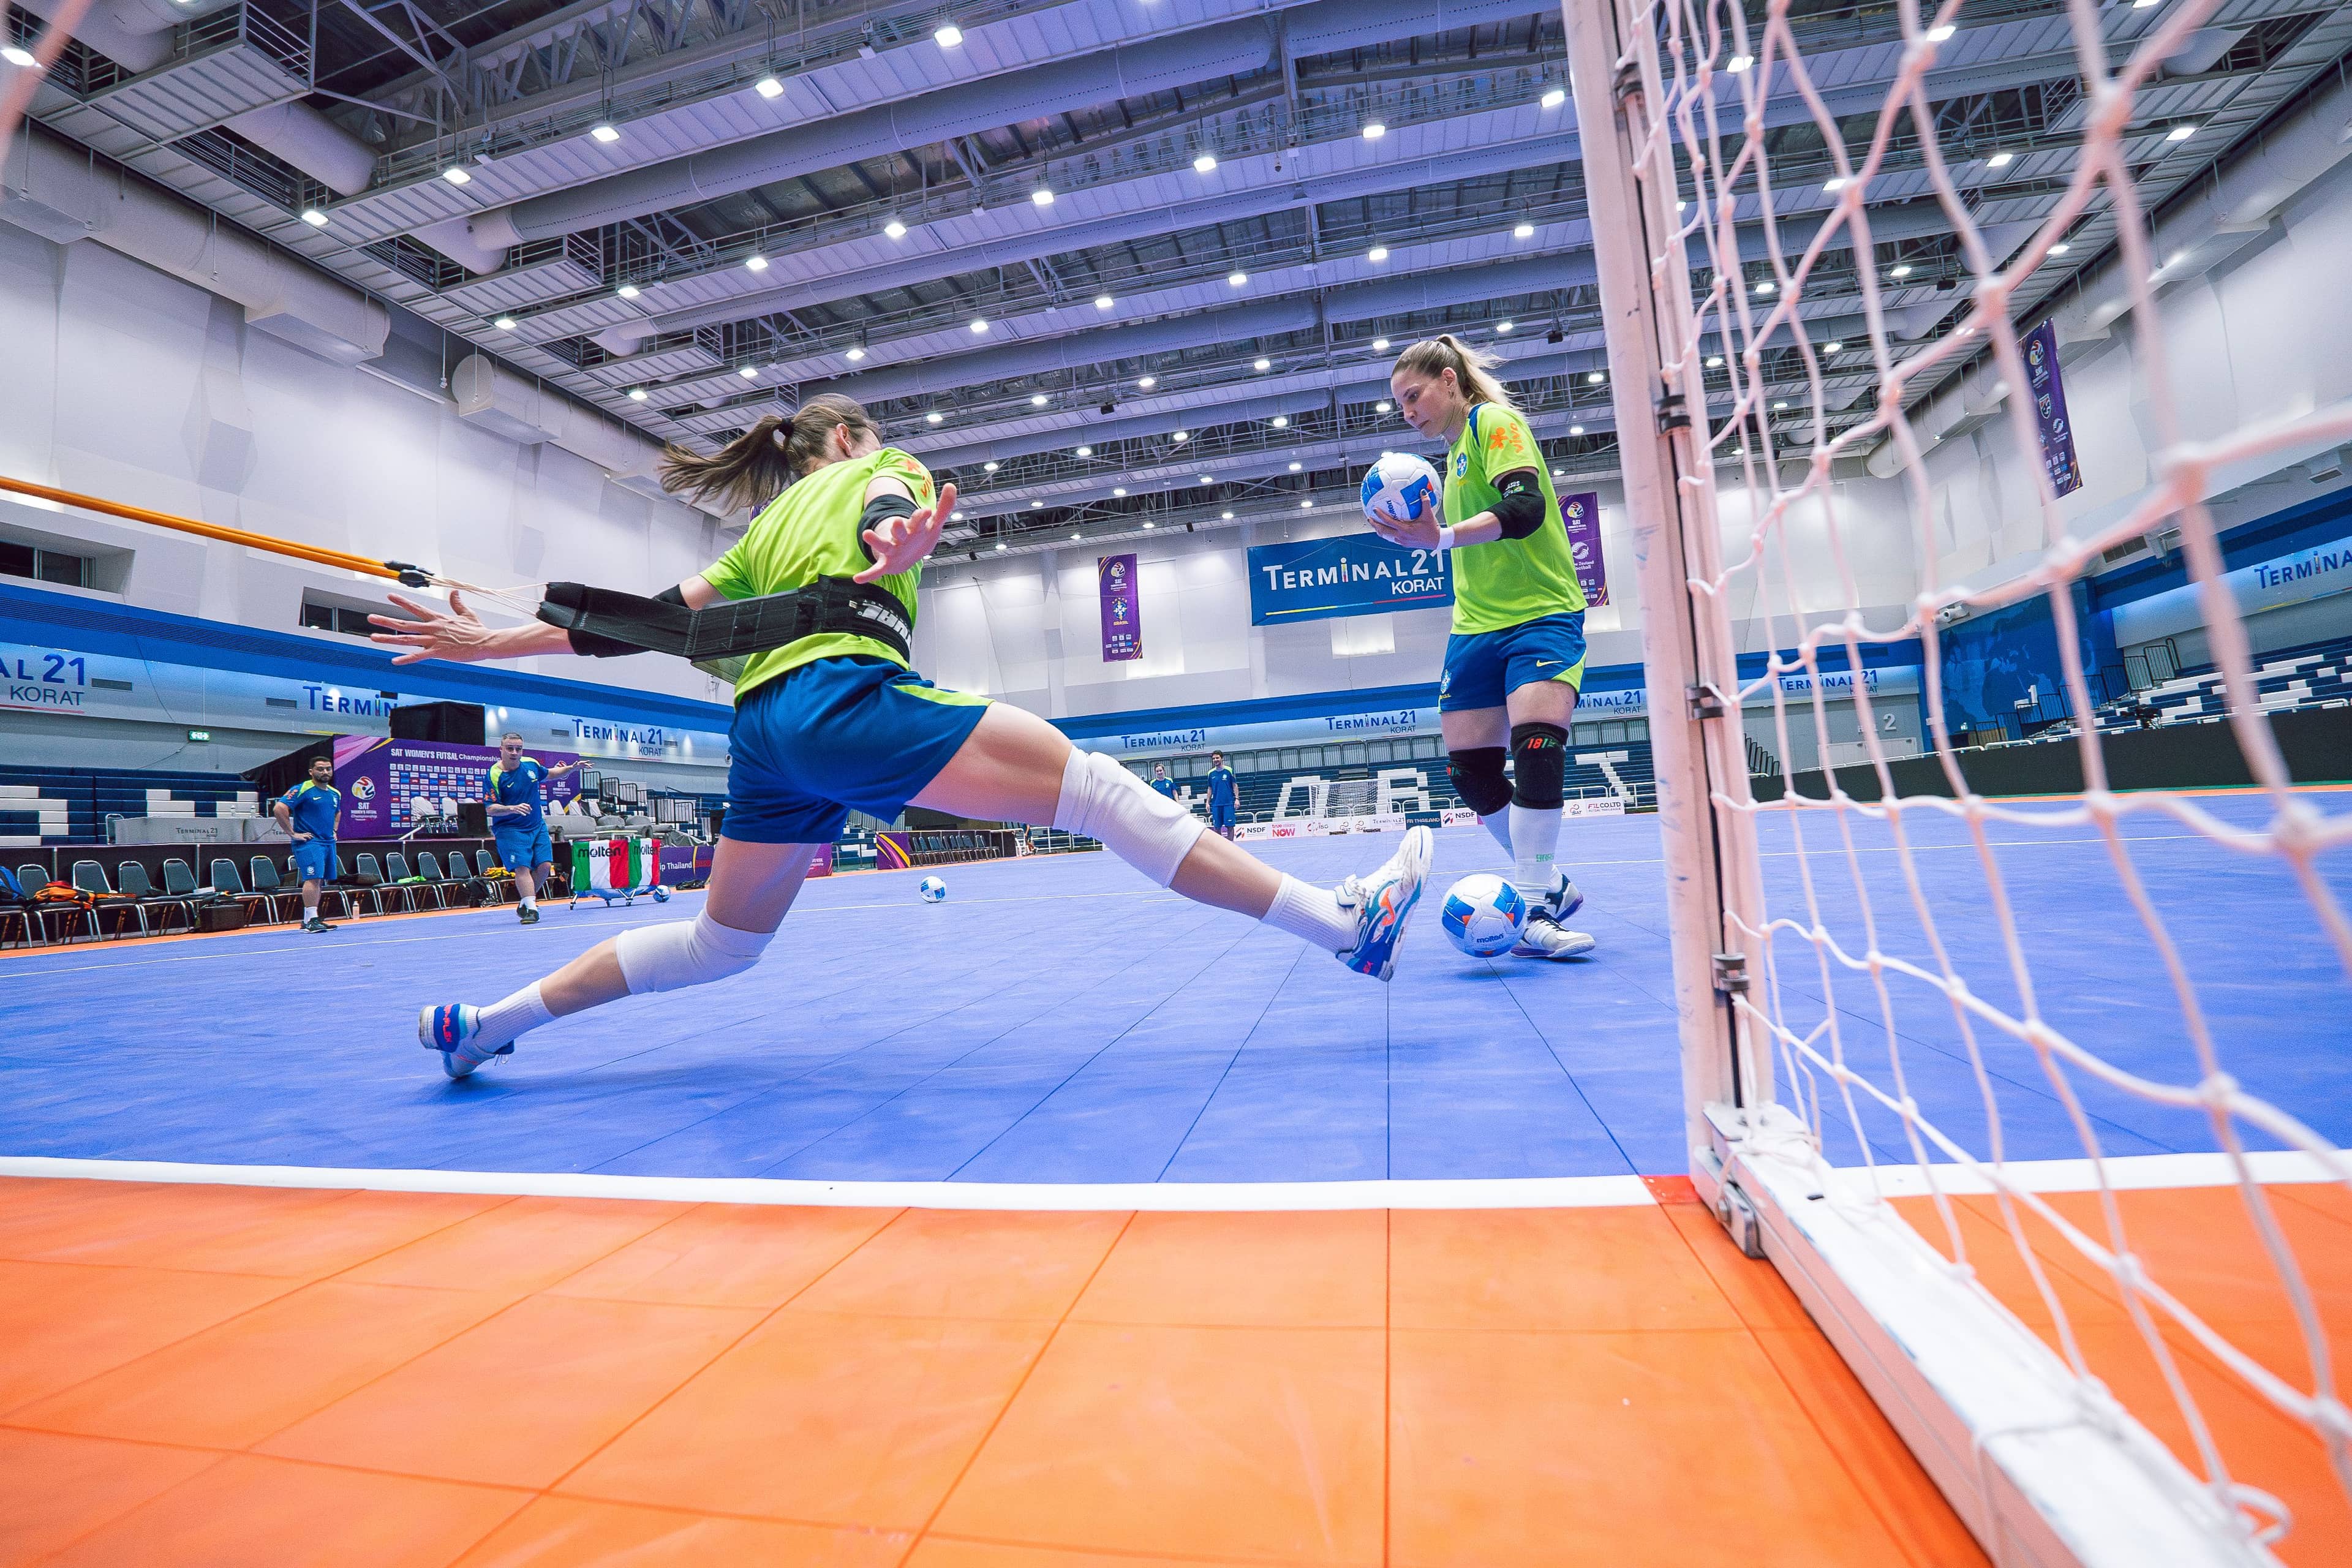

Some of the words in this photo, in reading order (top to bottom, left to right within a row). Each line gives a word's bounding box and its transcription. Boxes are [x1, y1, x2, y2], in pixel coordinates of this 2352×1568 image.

[1391, 576, 1445, 595] KORAT
[10, 685, 85, 706] KORAT
[1613, 706, 1641, 715] KORAT
[1883, 713, 1897, 731] 2
[1390, 725, 1416, 734] KORAT
[405, 749, 435, 759] WOMEN'S
[436, 751, 458, 760] FUTSAL
[639, 745, 663, 756] KORAT
[1272, 828, 1295, 837] NOW
[578, 846, 621, 858] molten
[633, 844, 659, 856] molten
[1477, 933, 1504, 943] molten
